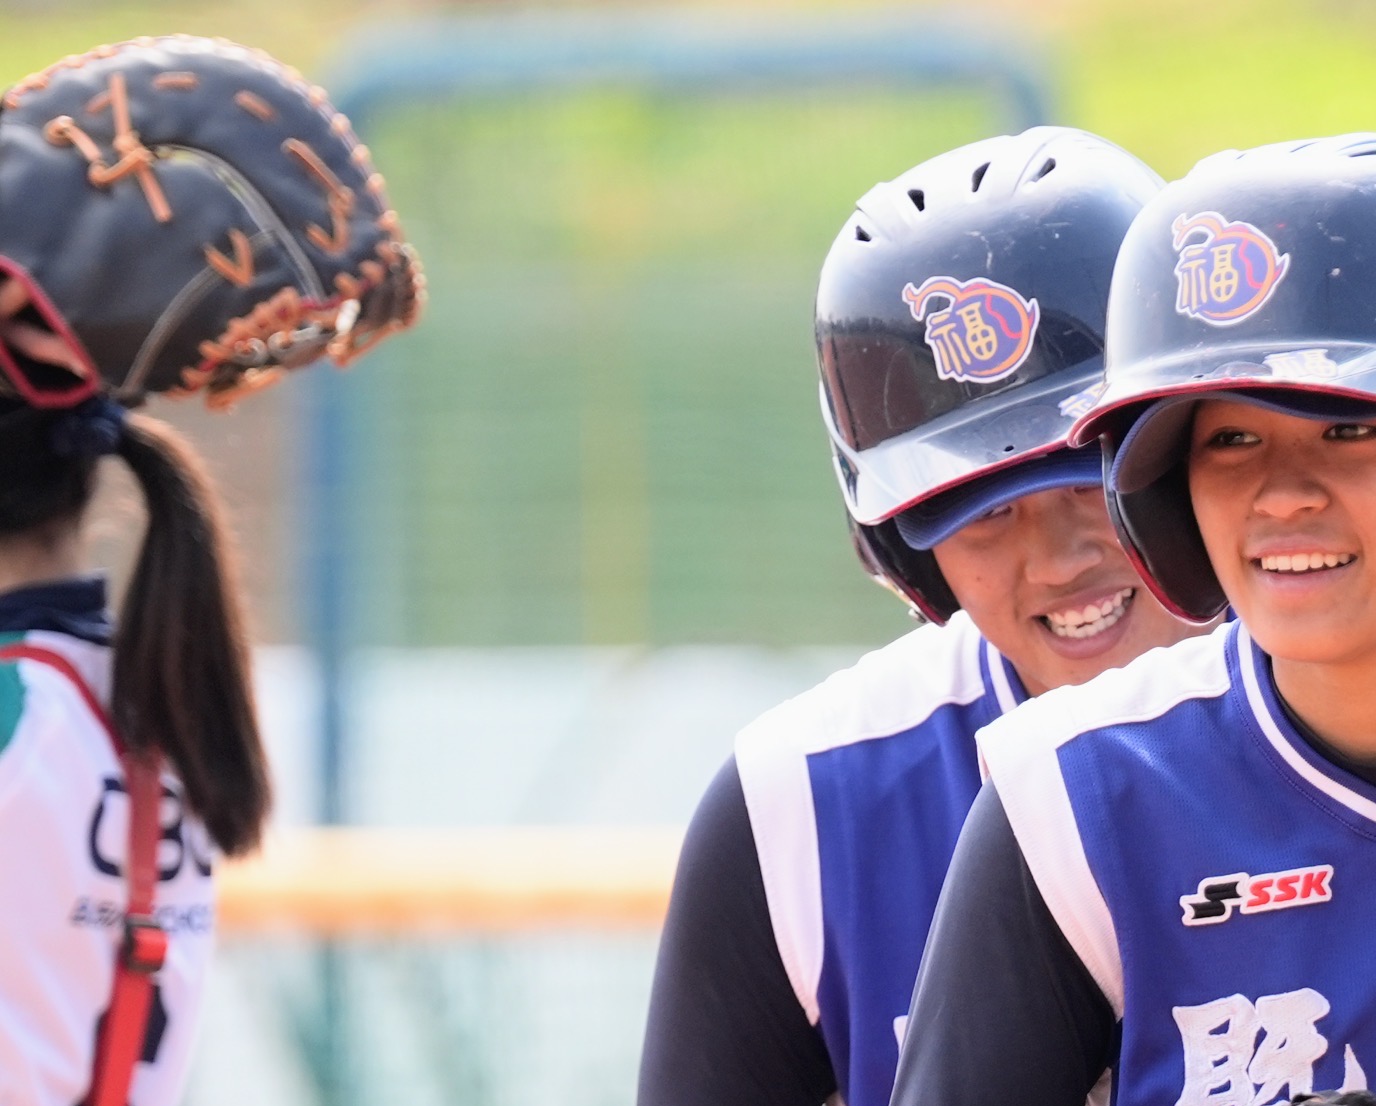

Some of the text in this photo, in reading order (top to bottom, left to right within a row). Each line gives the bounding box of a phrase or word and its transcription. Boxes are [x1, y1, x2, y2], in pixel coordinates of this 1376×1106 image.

[1180, 244, 1240, 308] 福
[929, 301, 998, 374] 福
[1246, 870, 1328, 908] SSK
